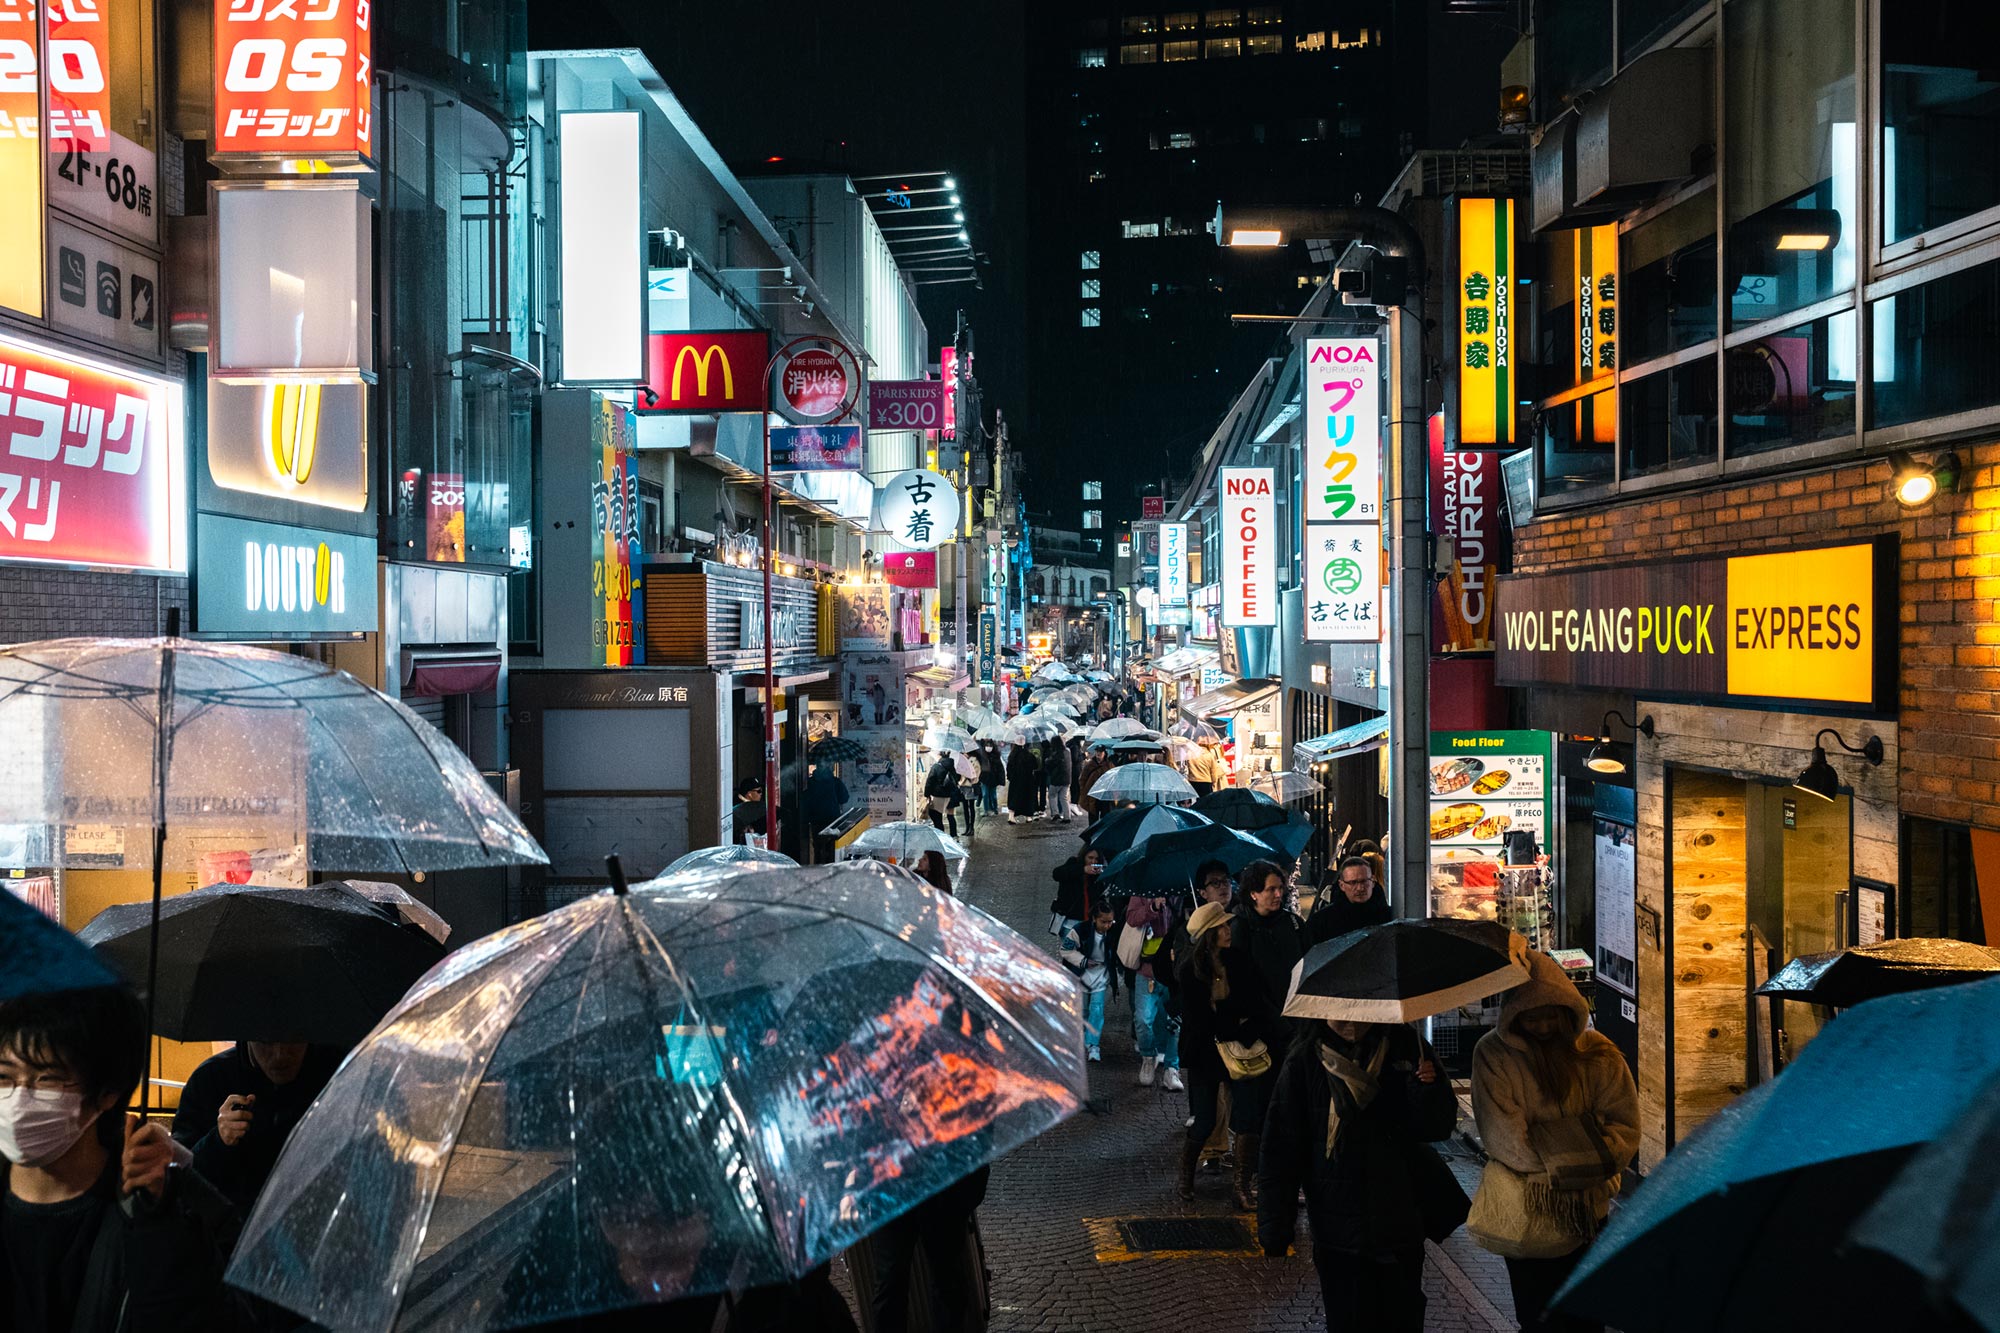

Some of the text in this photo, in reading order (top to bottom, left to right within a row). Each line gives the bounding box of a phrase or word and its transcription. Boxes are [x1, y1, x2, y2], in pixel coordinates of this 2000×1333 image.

[225, 38, 347, 92] OS
[224, 108, 350, 137] ドラッグ
[1464, 271, 1490, 369] 吉野家
[792, 358, 836, 366] FIRE HYDRANT
[1310, 346, 1374, 363] NOA
[1319, 365, 1366, 374] PURIKURA
[788, 369, 842, 395] 消火栓
[877, 388, 937, 398] PARIS KID'S
[876, 402, 936, 426] ¥300
[1323, 377, 1364, 519] プリクラ
[1227, 477, 1270, 496] NOA
[592, 459, 641, 549] 古着屋
[904, 474, 936, 543] 古着
[1360, 503, 1375, 513] B1
[1168, 527, 1178, 594] コインロッカー
[1240, 507, 1257, 618] COFFEE
[246, 541, 345, 614] DOUTOR
[1308, 600, 1372, 621] 吉そば
[593, 619, 643, 647] GRIZZLY
[1735, 604, 1861, 651] EXPRESS
[658, 686, 688, 702] 原宿
[1452, 737, 1504, 747] Food Floor
[1508, 757, 1538, 766] やきとり
[520, 802, 532, 814] 2
[79, 832, 106, 840] LEASE
[1604, 845, 1629, 861] DRINK MENU
[1638, 915, 1655, 939] OPEN
